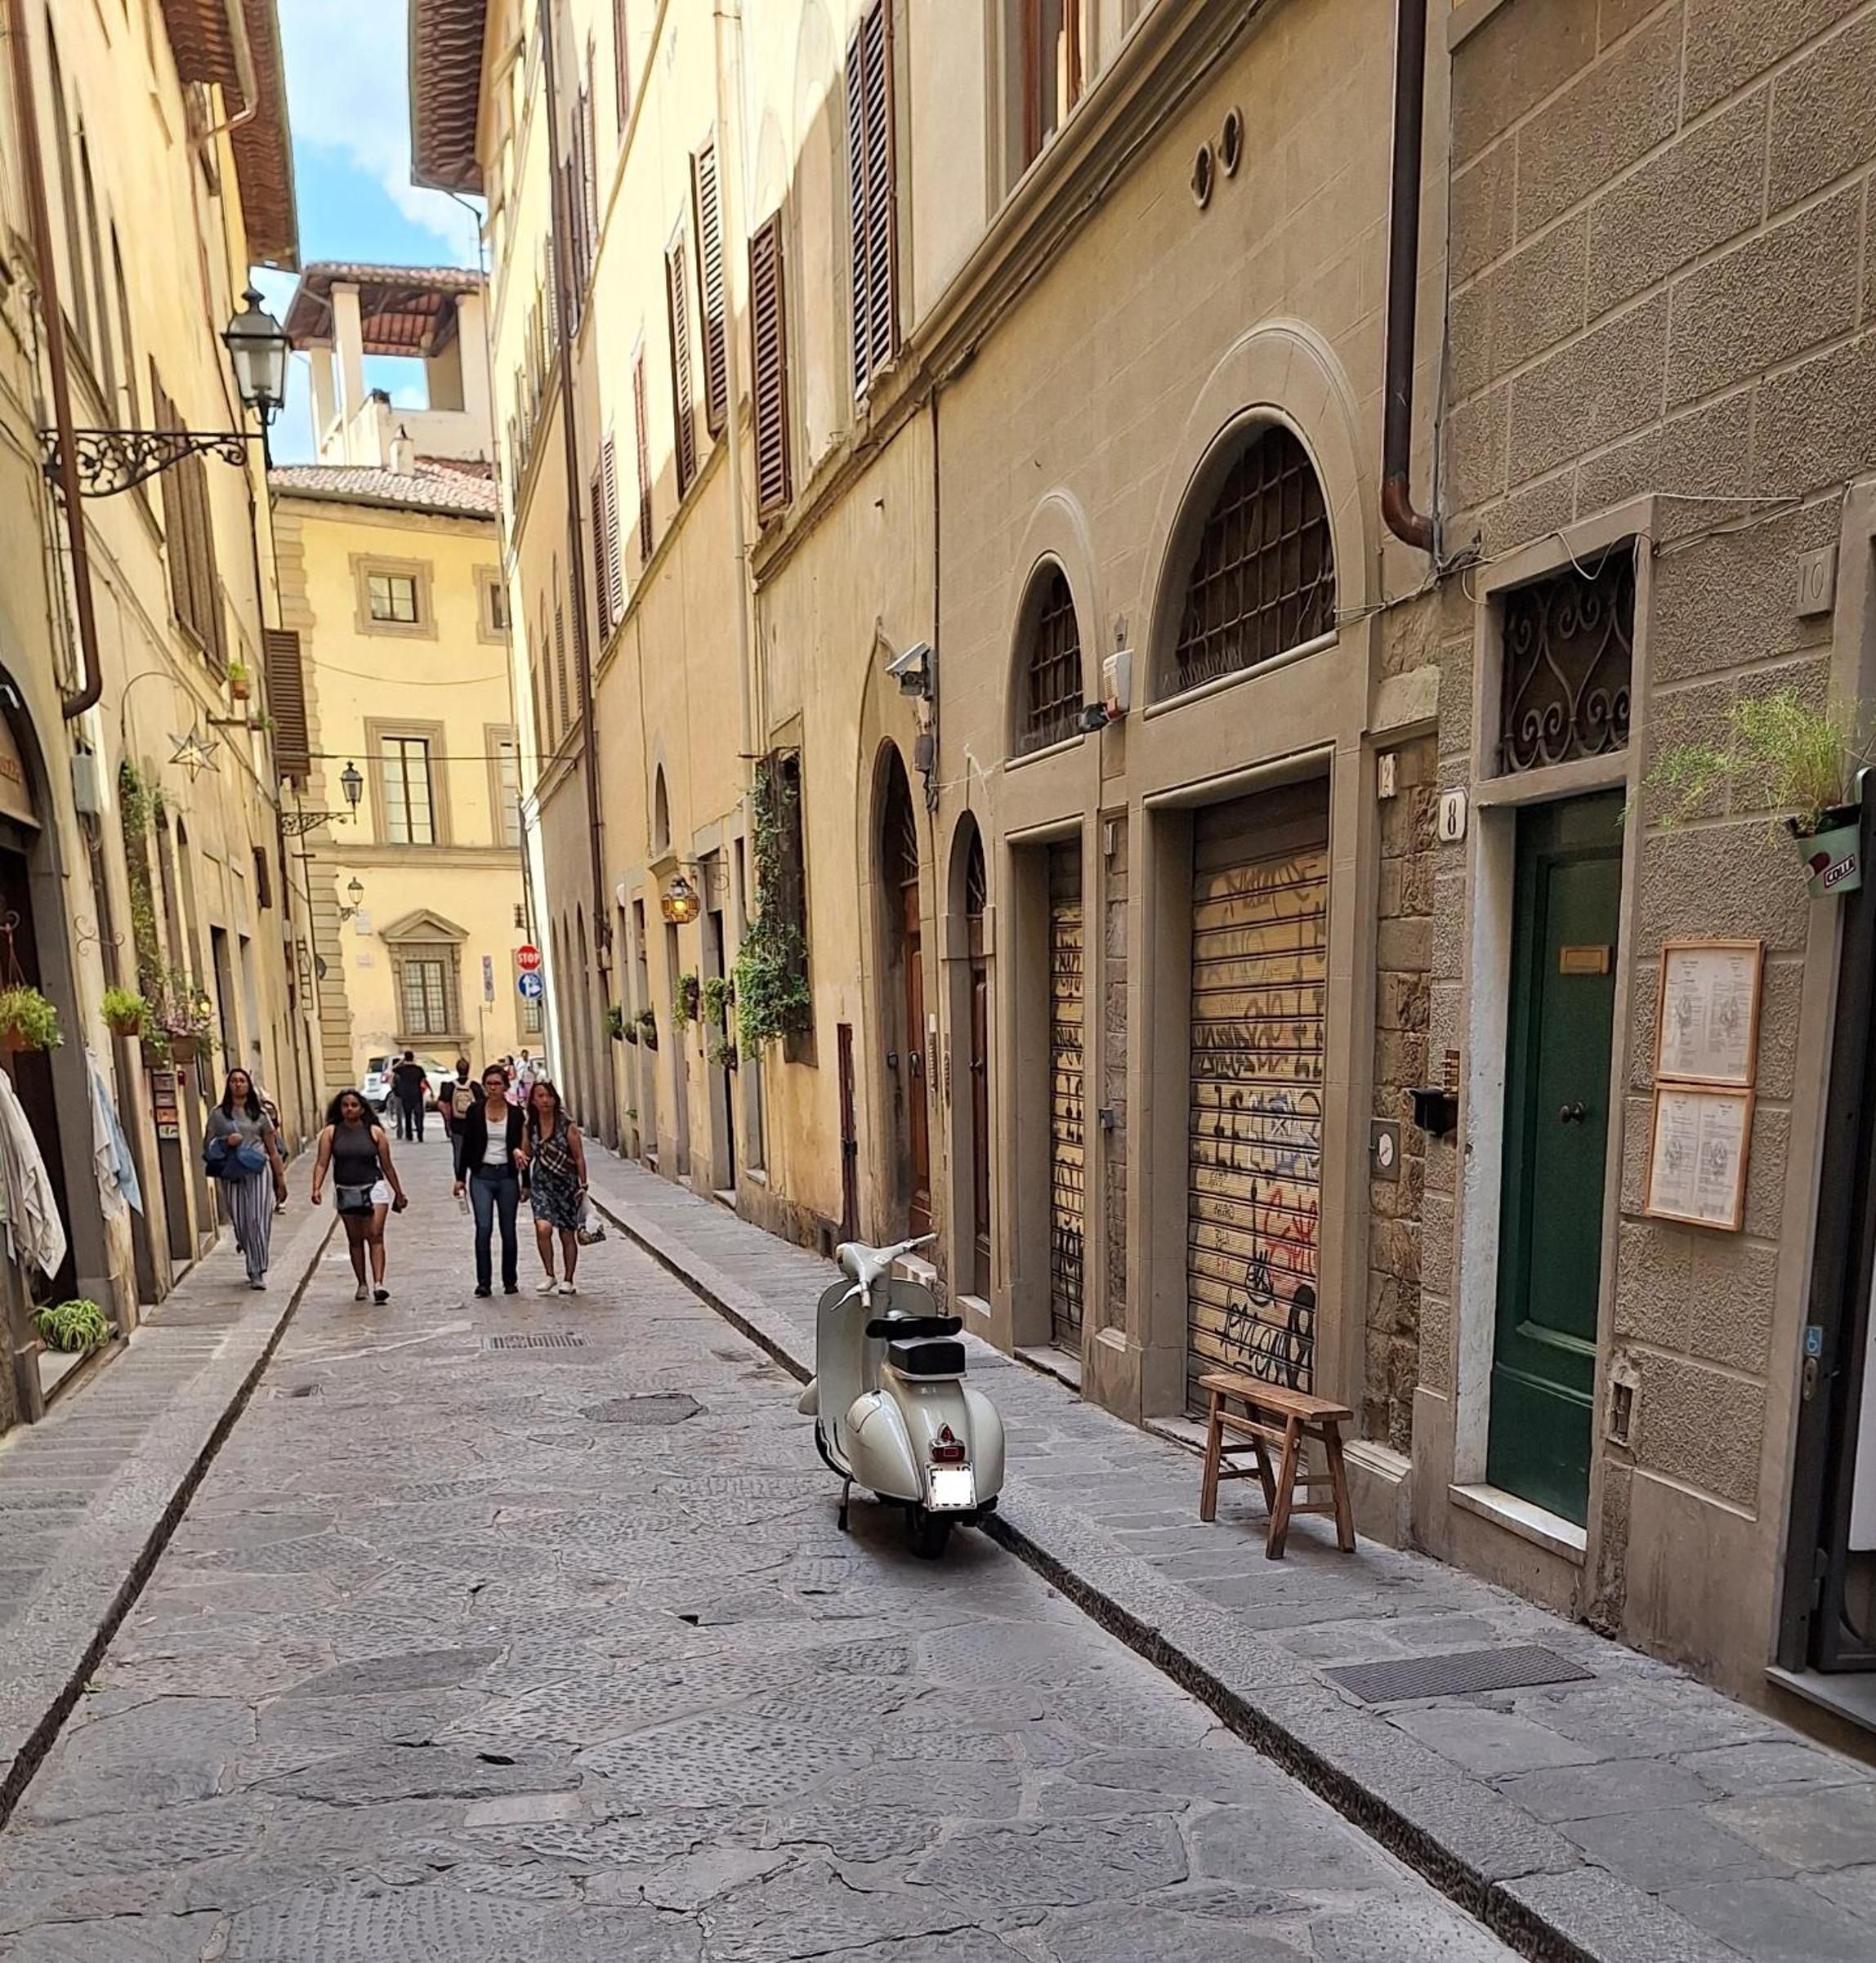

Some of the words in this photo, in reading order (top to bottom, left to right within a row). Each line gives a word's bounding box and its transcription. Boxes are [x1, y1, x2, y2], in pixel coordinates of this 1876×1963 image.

[1801, 562, 1824, 603] 10
[1448, 797, 1456, 835] 8
[518, 952, 541, 964] STOP
